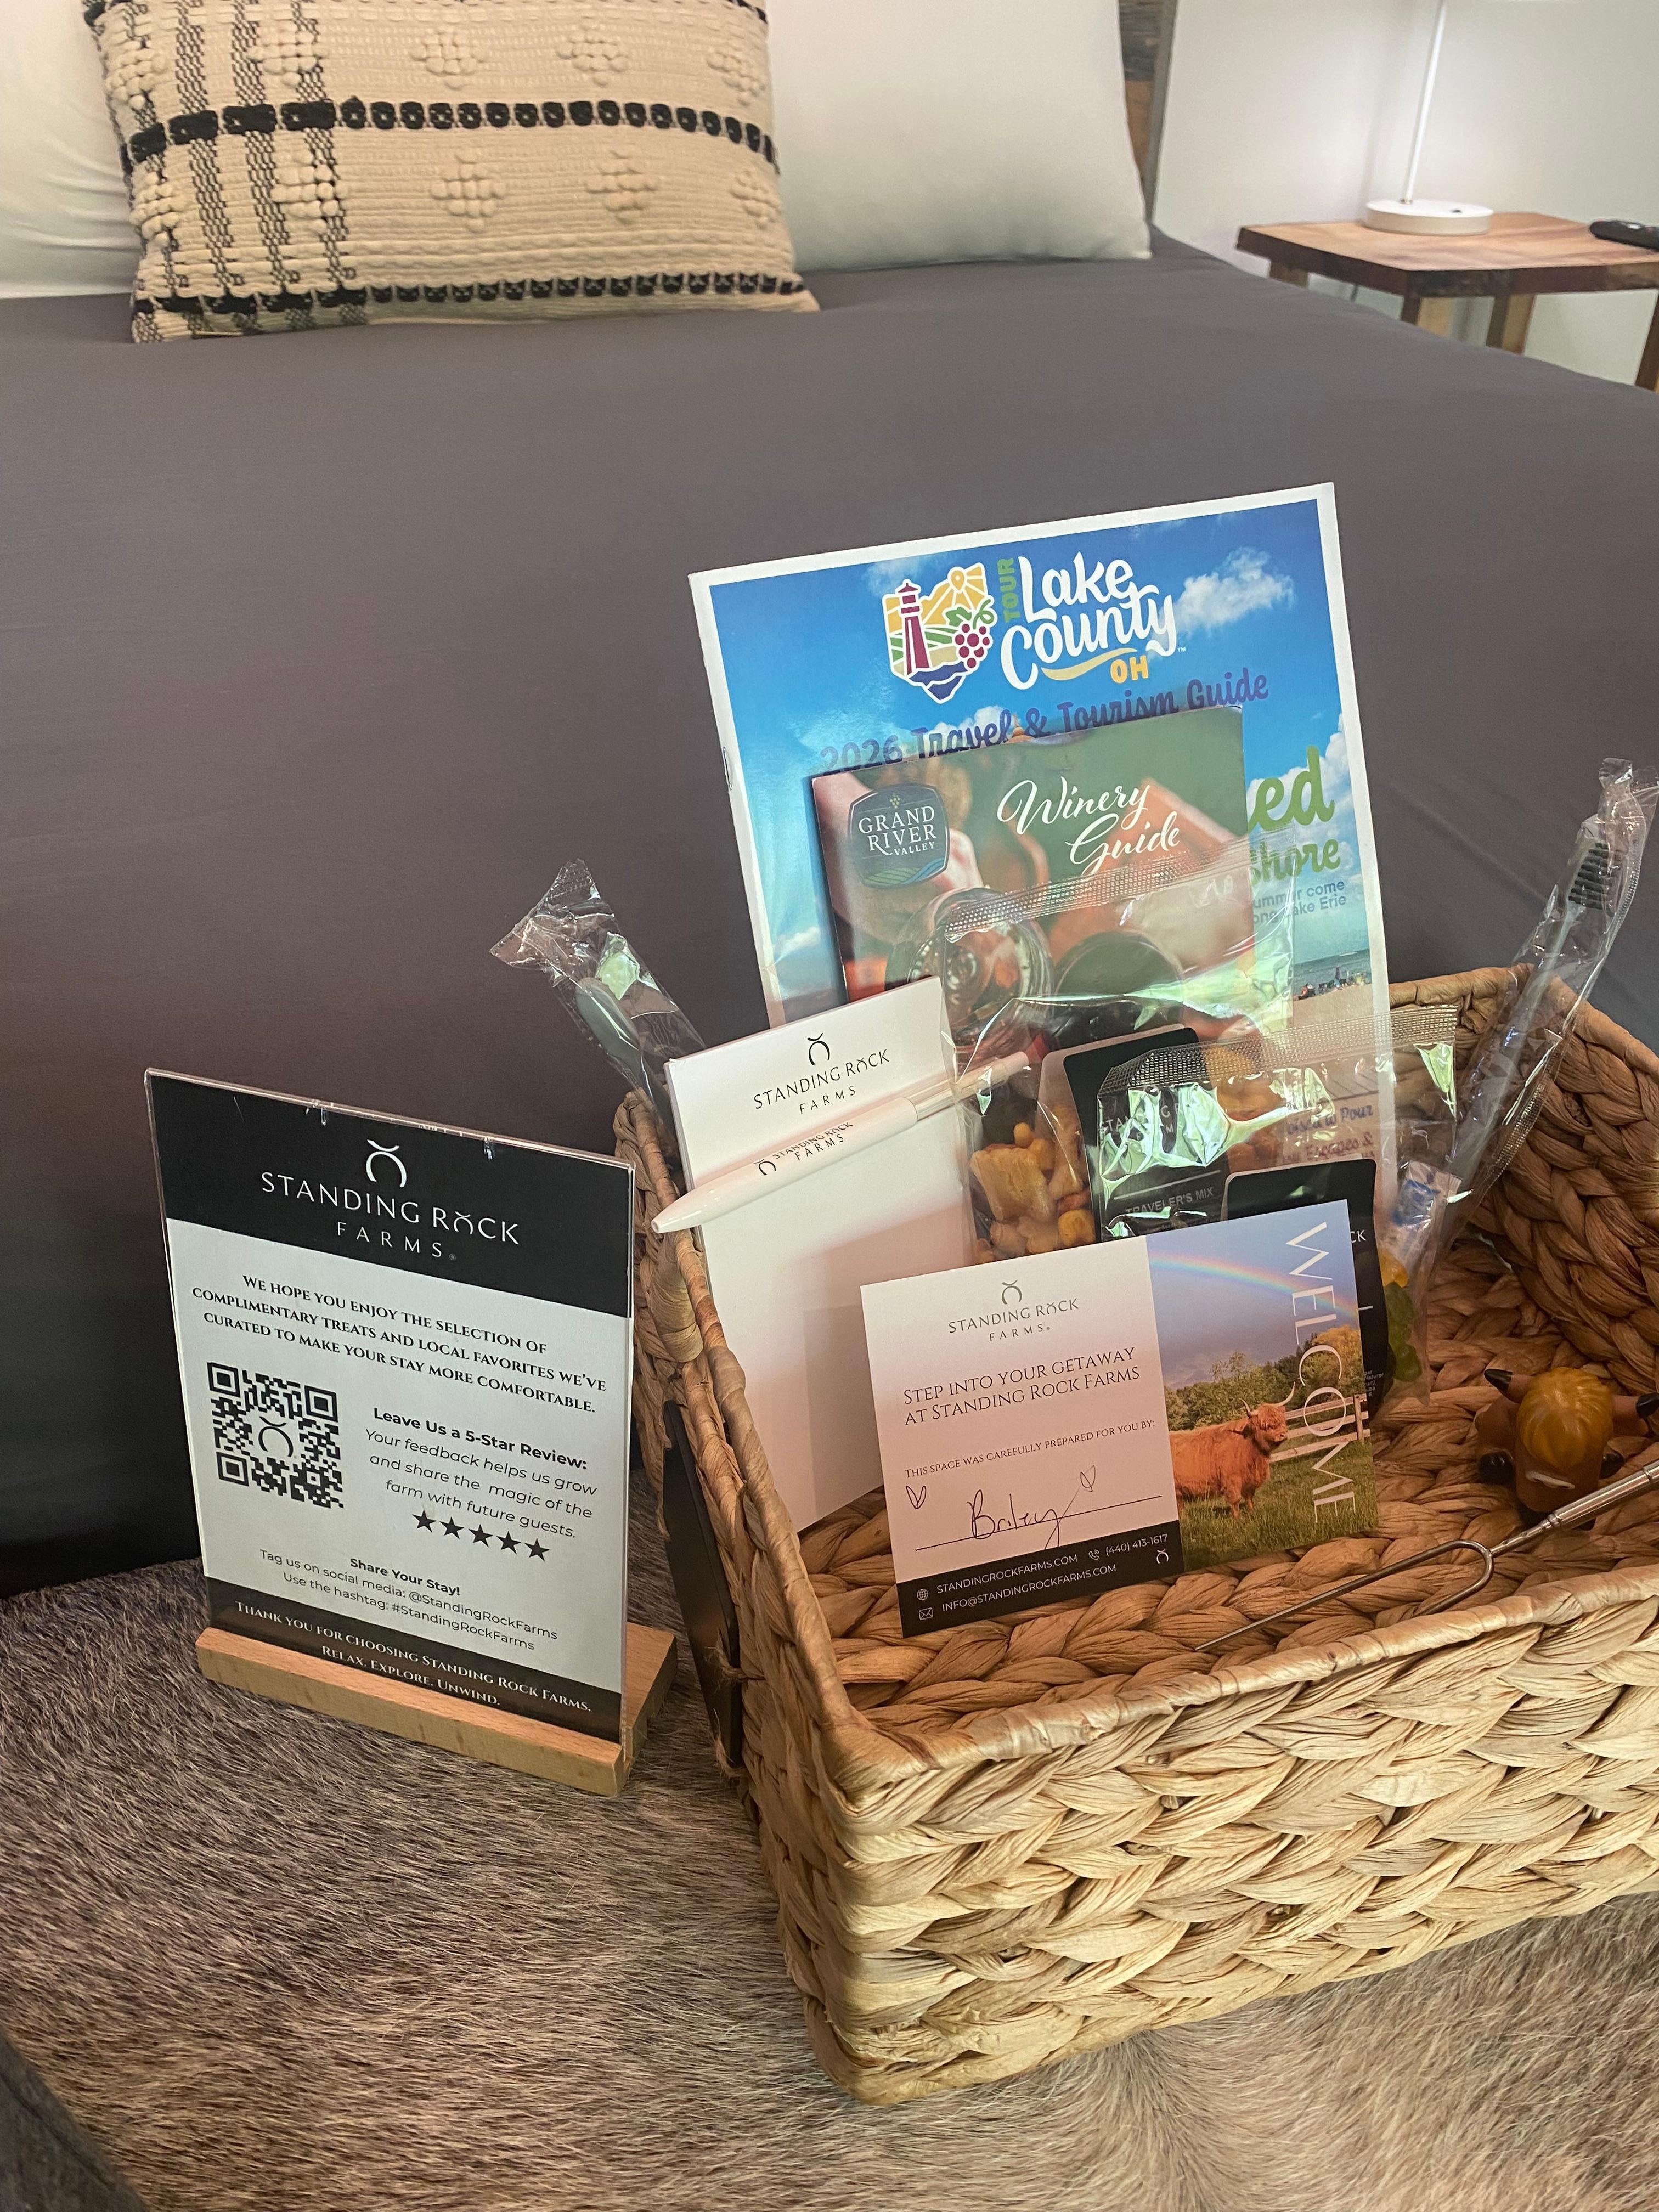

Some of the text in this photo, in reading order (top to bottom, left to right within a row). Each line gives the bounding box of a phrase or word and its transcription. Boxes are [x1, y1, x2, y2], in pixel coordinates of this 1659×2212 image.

[997, 558, 1020, 623] TOUR
[1018, 551, 1133, 623] Lake
[1001, 581, 1177, 690] County
[1110, 655, 1149, 684] OH
[820, 667, 1269, 769] 2026 Travel & Tourism Guide
[858, 806, 935, 834] GRAND
[997, 776, 1150, 835] Winery
[867, 824, 936, 856] RIVER
[894, 841, 935, 856] VALLEY
[1064, 811, 1180, 876] Guide
[1306, 881, 1345, 896] come
[1319, 894, 1347, 910] Erie
[754, 1049, 889, 1109] STANDING ROCK
[799, 1085, 855, 1114] FARMS
[772, 1122, 854, 1160] STANDING ROCK
[794, 1133, 844, 1160] FARMS
[261, 1172, 519, 1245] STANDING ROCK
[1195, 1187, 1214, 1200] MIX
[192, 1288, 318, 1325] COMPLIMENTARY
[321, 1317, 376, 1339] TREATS
[380, 1331, 414, 1346] AND
[419, 1339, 470, 1359] LOCAL
[473, 1351, 555, 1380] FAVORITES
[242, 1275, 547, 1354] WE HOPE YOU ENJOY THE SELECTION OF
[949, 1298, 1079, 1333] STANDING ROCK
[204, 1312, 595, 1413] CURATED TO MAKE YOUR STAY MORE COMFORTABLE.
[904, 1346, 1135, 1404] STEP INTO YOUR GETAWAY
[1285, 1222, 1356, 1523] WELCOME
[905, 1366, 1139, 1426] AT STANDING ROCK FARMS
[365, 1428, 597, 1496] Your feedback helps us grow
[374, 1407, 587, 1470] Leave Us a 5-Star Review:
[905, 1419, 1155, 1479] THIS SPACE WAS CAREFULLY PREPARED FOR YOU BY:
[370, 1455, 592, 1519] and share the magic of the
[386, 1480, 575, 1538] farm with future guests.
[966, 1489, 1060, 1550] Briley
[350, 1558, 460, 1596] Share Your Stay!
[936, 1533, 1168, 1594] STANDINGROCKFARMS.COM (440) 413-1617
[943, 1564, 1116, 1612] INFO@STANDINGROCKFARMS.COM
[259, 1549, 558, 1640] Tag us on social media: @StandingRockFarms
[284, 1572, 535, 1650] Use the hashtag: #StandingRockFarms
[235, 1601, 591, 1712] THANK YOU FOR CHOOSING STANDING ROCK FARMS.
[322, 1645, 500, 1705] RELAX. EXPLORE. UNWIND.
